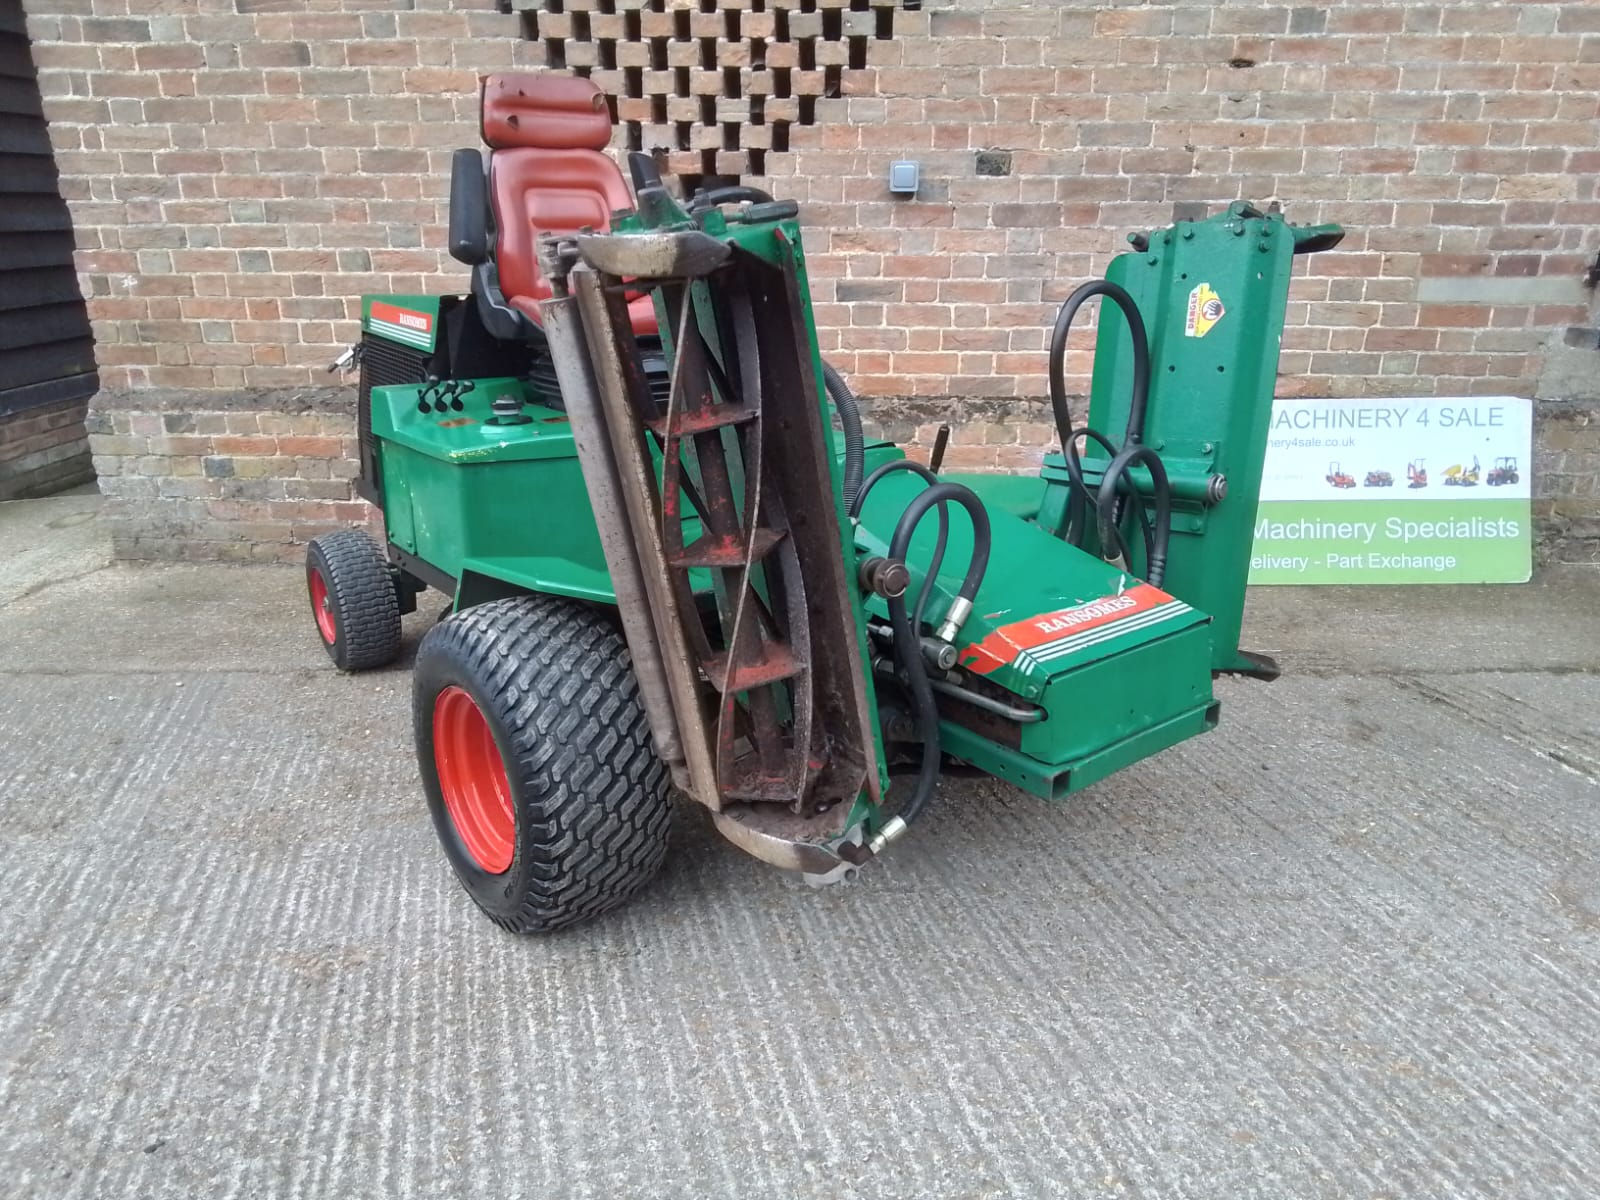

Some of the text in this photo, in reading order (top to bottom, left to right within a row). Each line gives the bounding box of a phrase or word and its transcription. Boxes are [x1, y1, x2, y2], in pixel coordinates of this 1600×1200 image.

[1188, 292, 1198, 329] DANGER
[1415, 407, 1430, 428] 4
[1439, 406, 1505, 428] SALE
[1254, 516, 1520, 544] Machinery Specialists
[1250, 553, 1309, 572] elivery
[1326, 553, 1363, 569] Part
[1368, 552, 1457, 573] Exchange
[1034, 595, 1137, 634] RANSOMES
